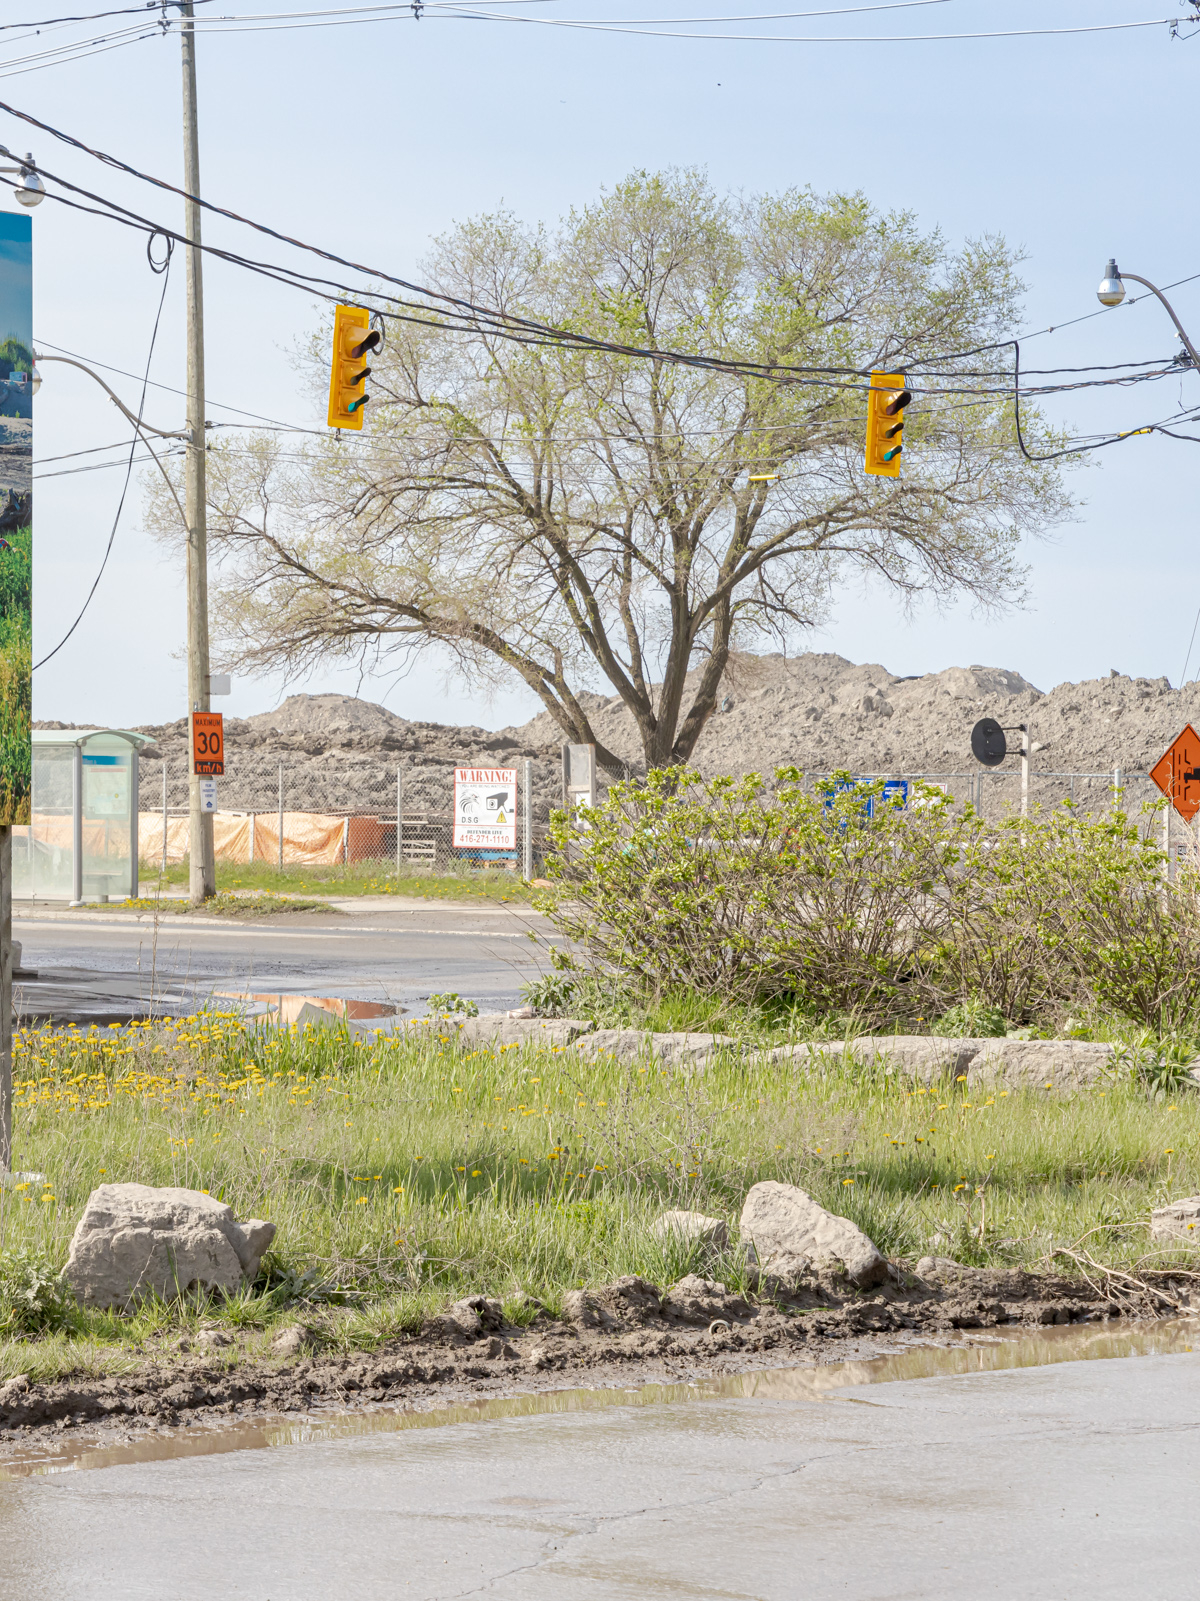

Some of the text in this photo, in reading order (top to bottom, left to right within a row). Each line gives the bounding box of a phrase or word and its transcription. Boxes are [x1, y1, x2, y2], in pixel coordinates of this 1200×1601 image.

[195, 718, 221, 727] MAXIMUM
[197, 732, 220, 754] 30
[196, 762, 222, 774] km/h
[460, 770, 512, 782] WARNING!
[459, 834, 510, 844] 416-271-1110
